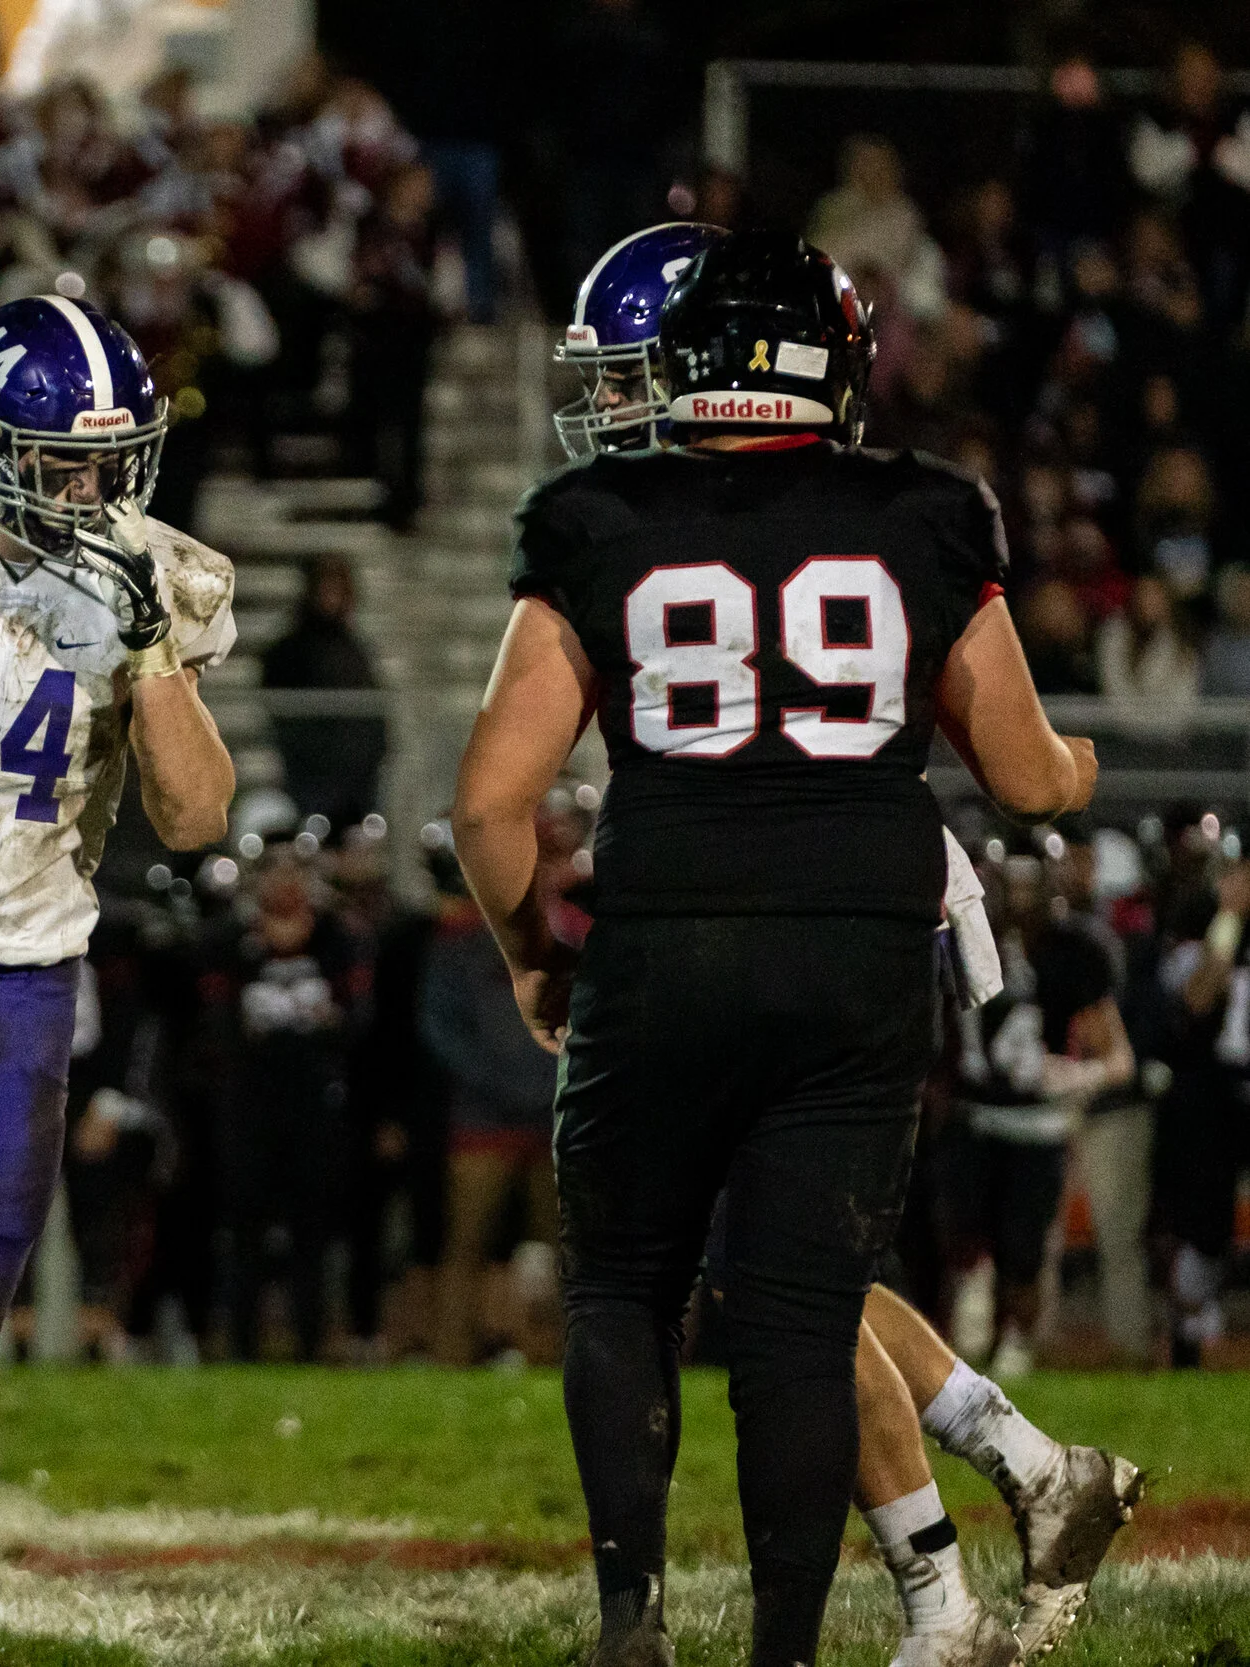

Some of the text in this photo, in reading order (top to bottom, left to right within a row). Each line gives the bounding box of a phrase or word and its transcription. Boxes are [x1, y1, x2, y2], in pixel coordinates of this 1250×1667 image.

[692, 397, 792, 419] Riddell
[81, 412, 129, 428] Riddell
[623, 554, 912, 759] 89
